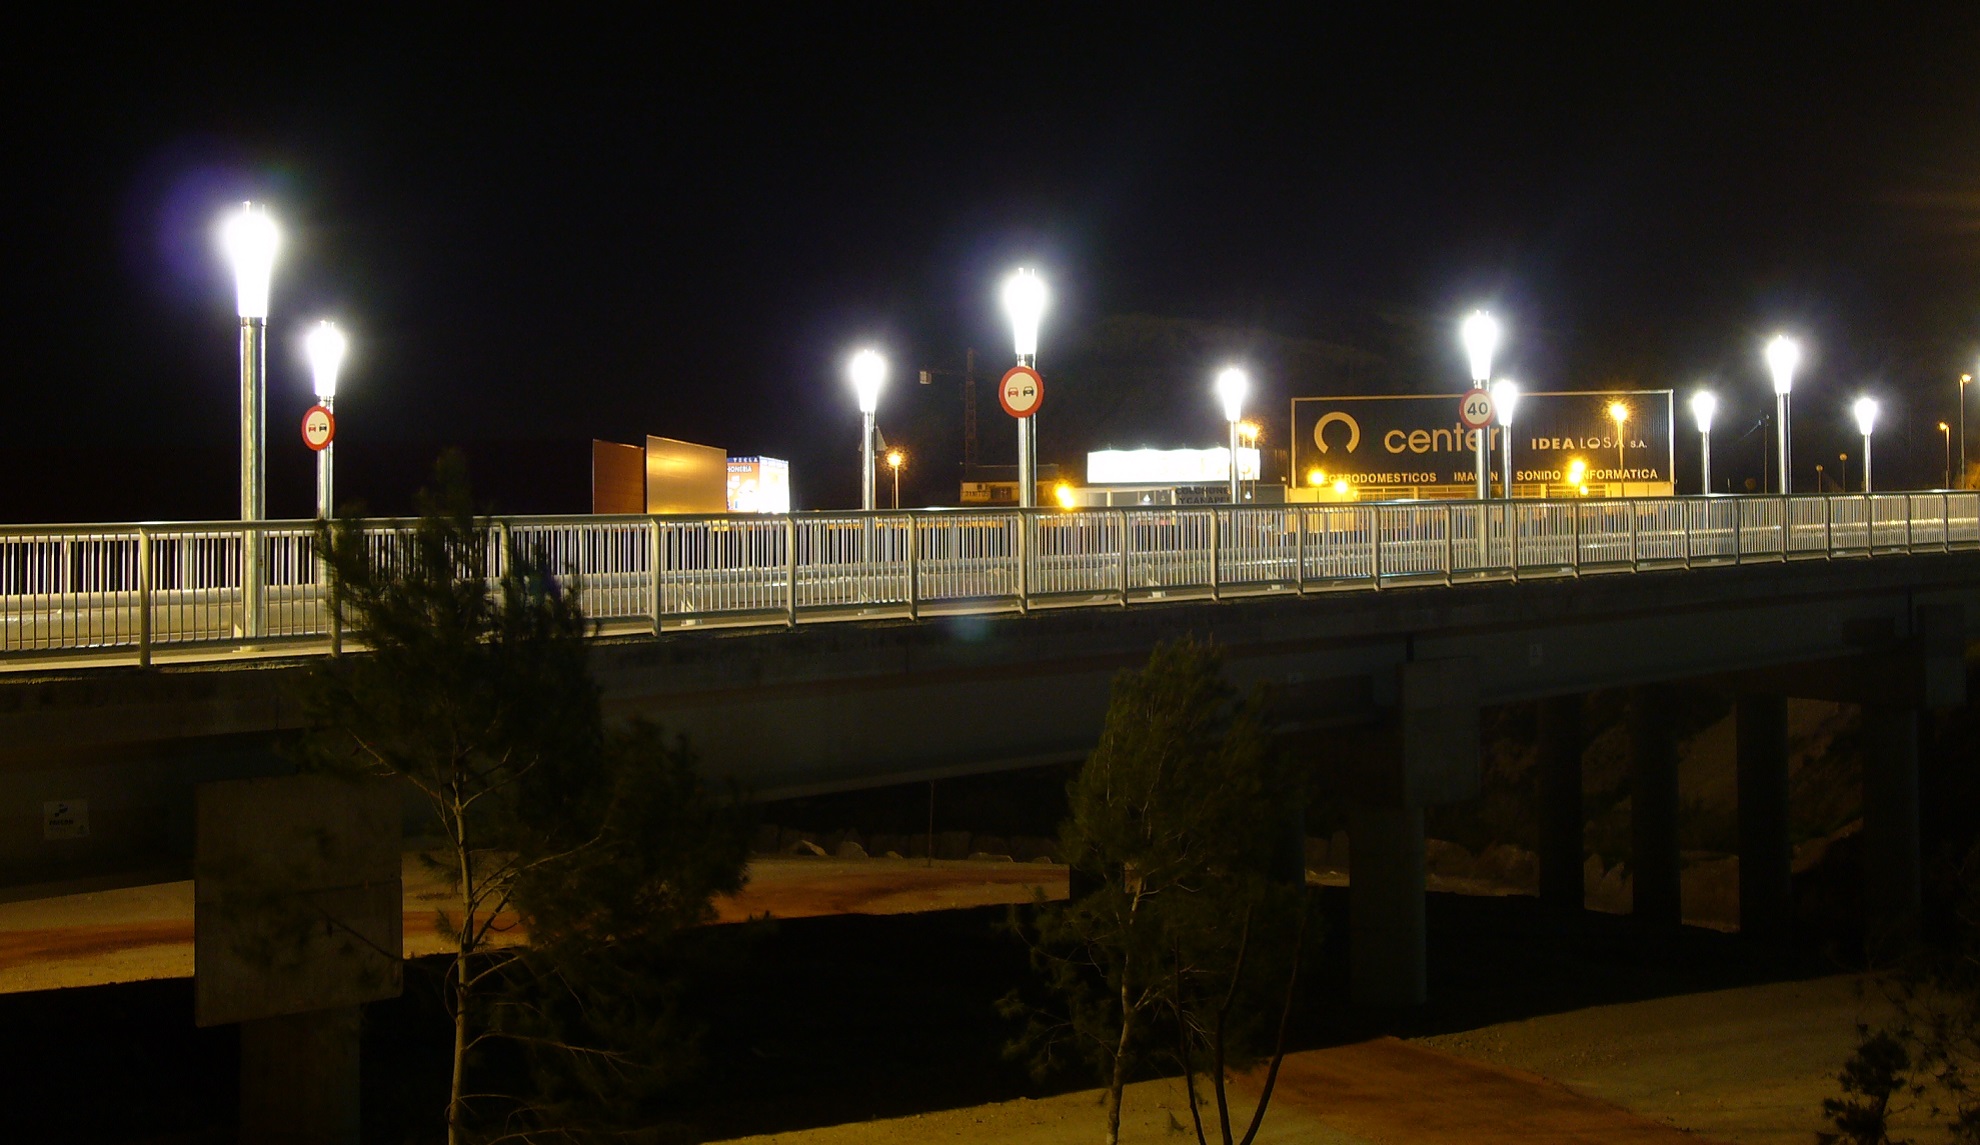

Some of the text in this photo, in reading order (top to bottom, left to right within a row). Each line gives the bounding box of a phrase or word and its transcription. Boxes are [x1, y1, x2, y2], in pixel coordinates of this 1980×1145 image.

[1467, 401, 1489, 415] 40
[1532, 436, 1648, 450] IDEA LOSA S.A.
[1308, 469, 1658, 484] ECTRODOMESTICOS IMAN SONIDO NFORMATICA
